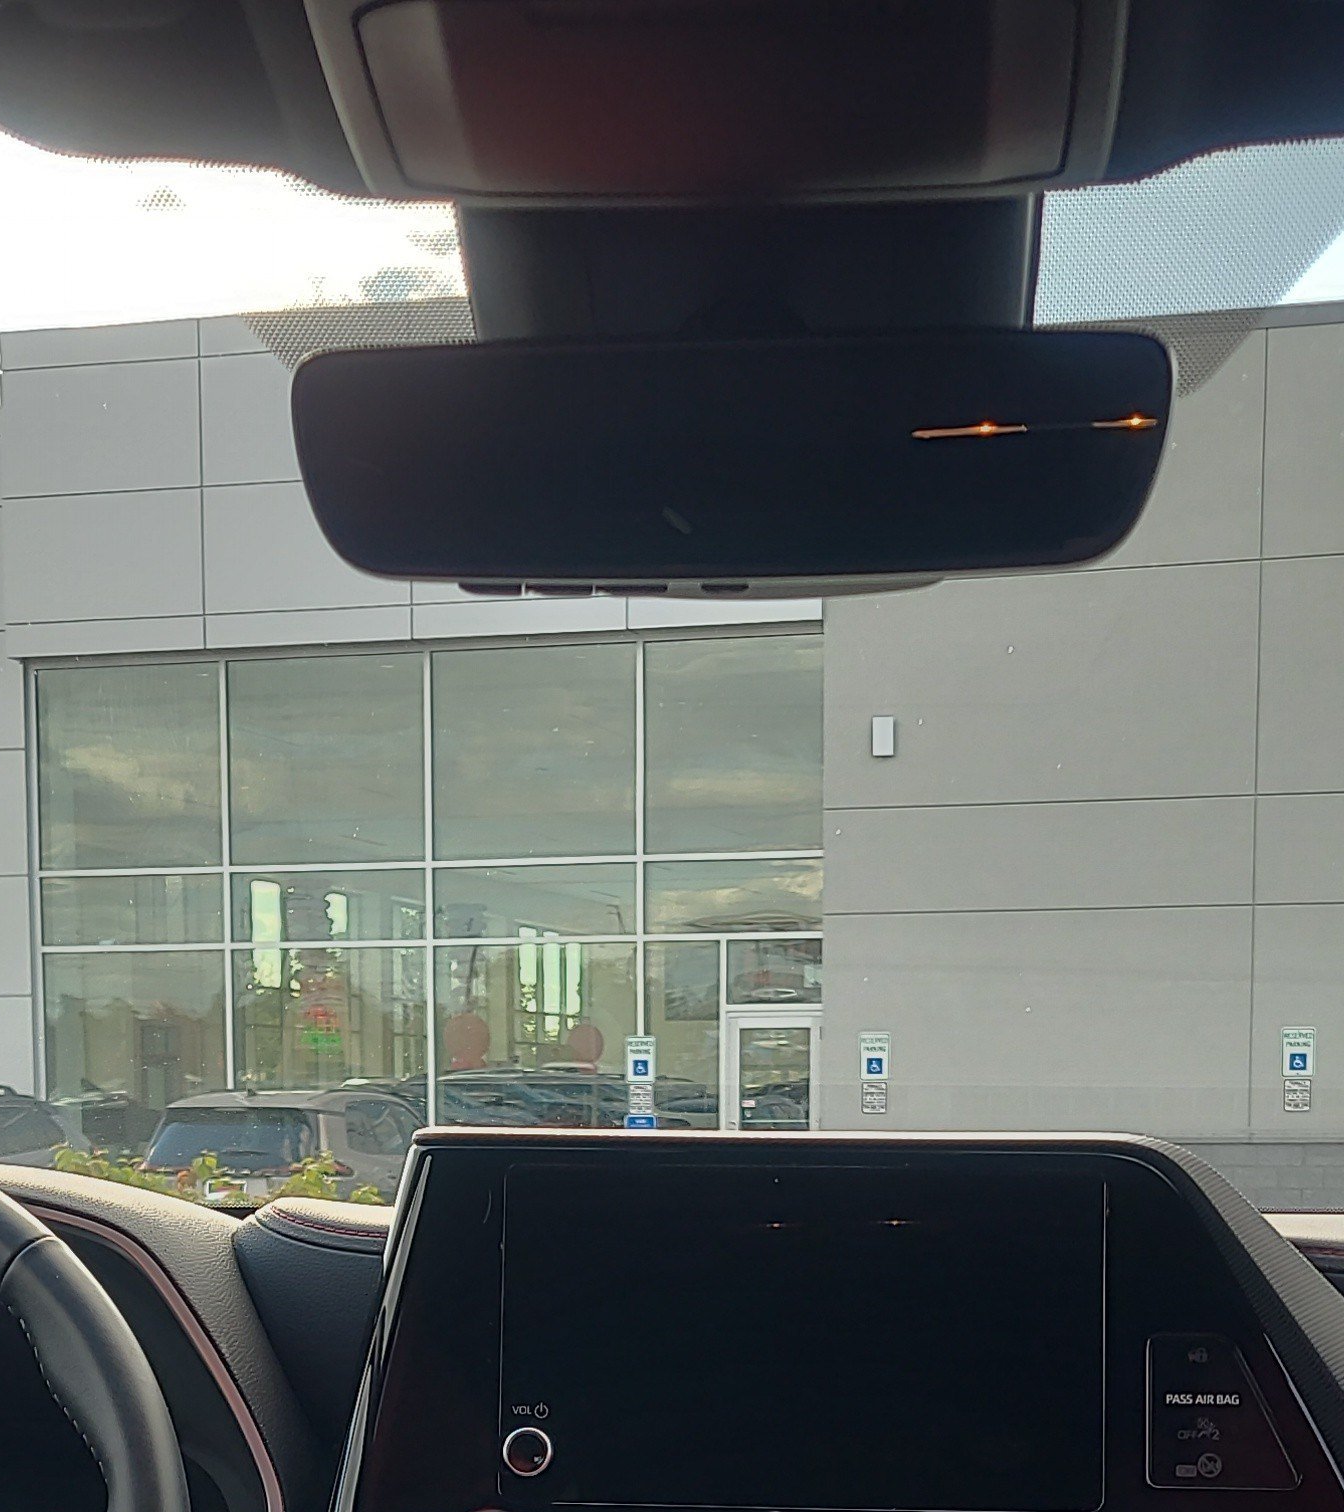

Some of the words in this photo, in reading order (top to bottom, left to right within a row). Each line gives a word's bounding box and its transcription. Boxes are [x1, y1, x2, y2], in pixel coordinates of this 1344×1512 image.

[1166, 1394, 1193, 1404] PASS
[1195, 1394, 1215, 1404] AIR
[1216, 1394, 1240, 1405] BAG
[512, 1405, 532, 1415] VOL
